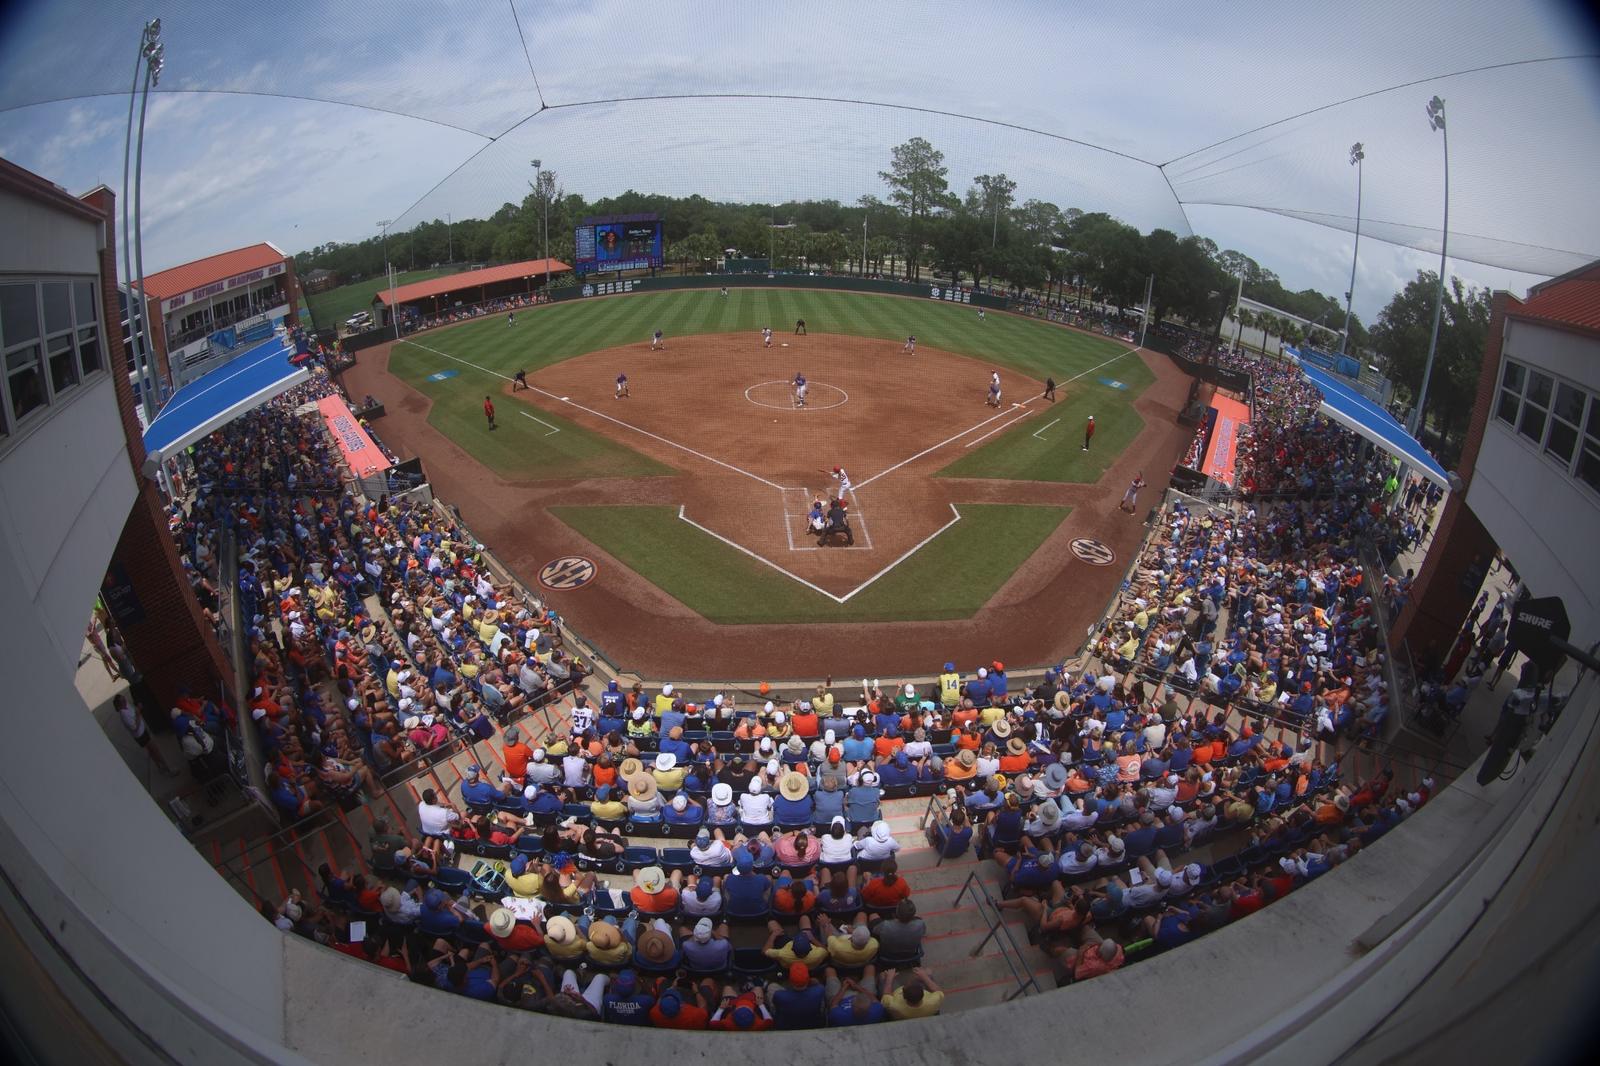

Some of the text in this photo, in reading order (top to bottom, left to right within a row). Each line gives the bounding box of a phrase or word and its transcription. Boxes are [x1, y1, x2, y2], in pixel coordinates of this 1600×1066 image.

[192, 281, 224, 301] NATIONAL
[1071, 539, 1113, 564] SEC
[541, 558, 593, 588] SEC
[1518, 612, 1553, 630] SHURE
[946, 679, 958, 690] 14
[573, 715, 588, 729] 27
[608, 1000, 642, 1010] FLORIDA
